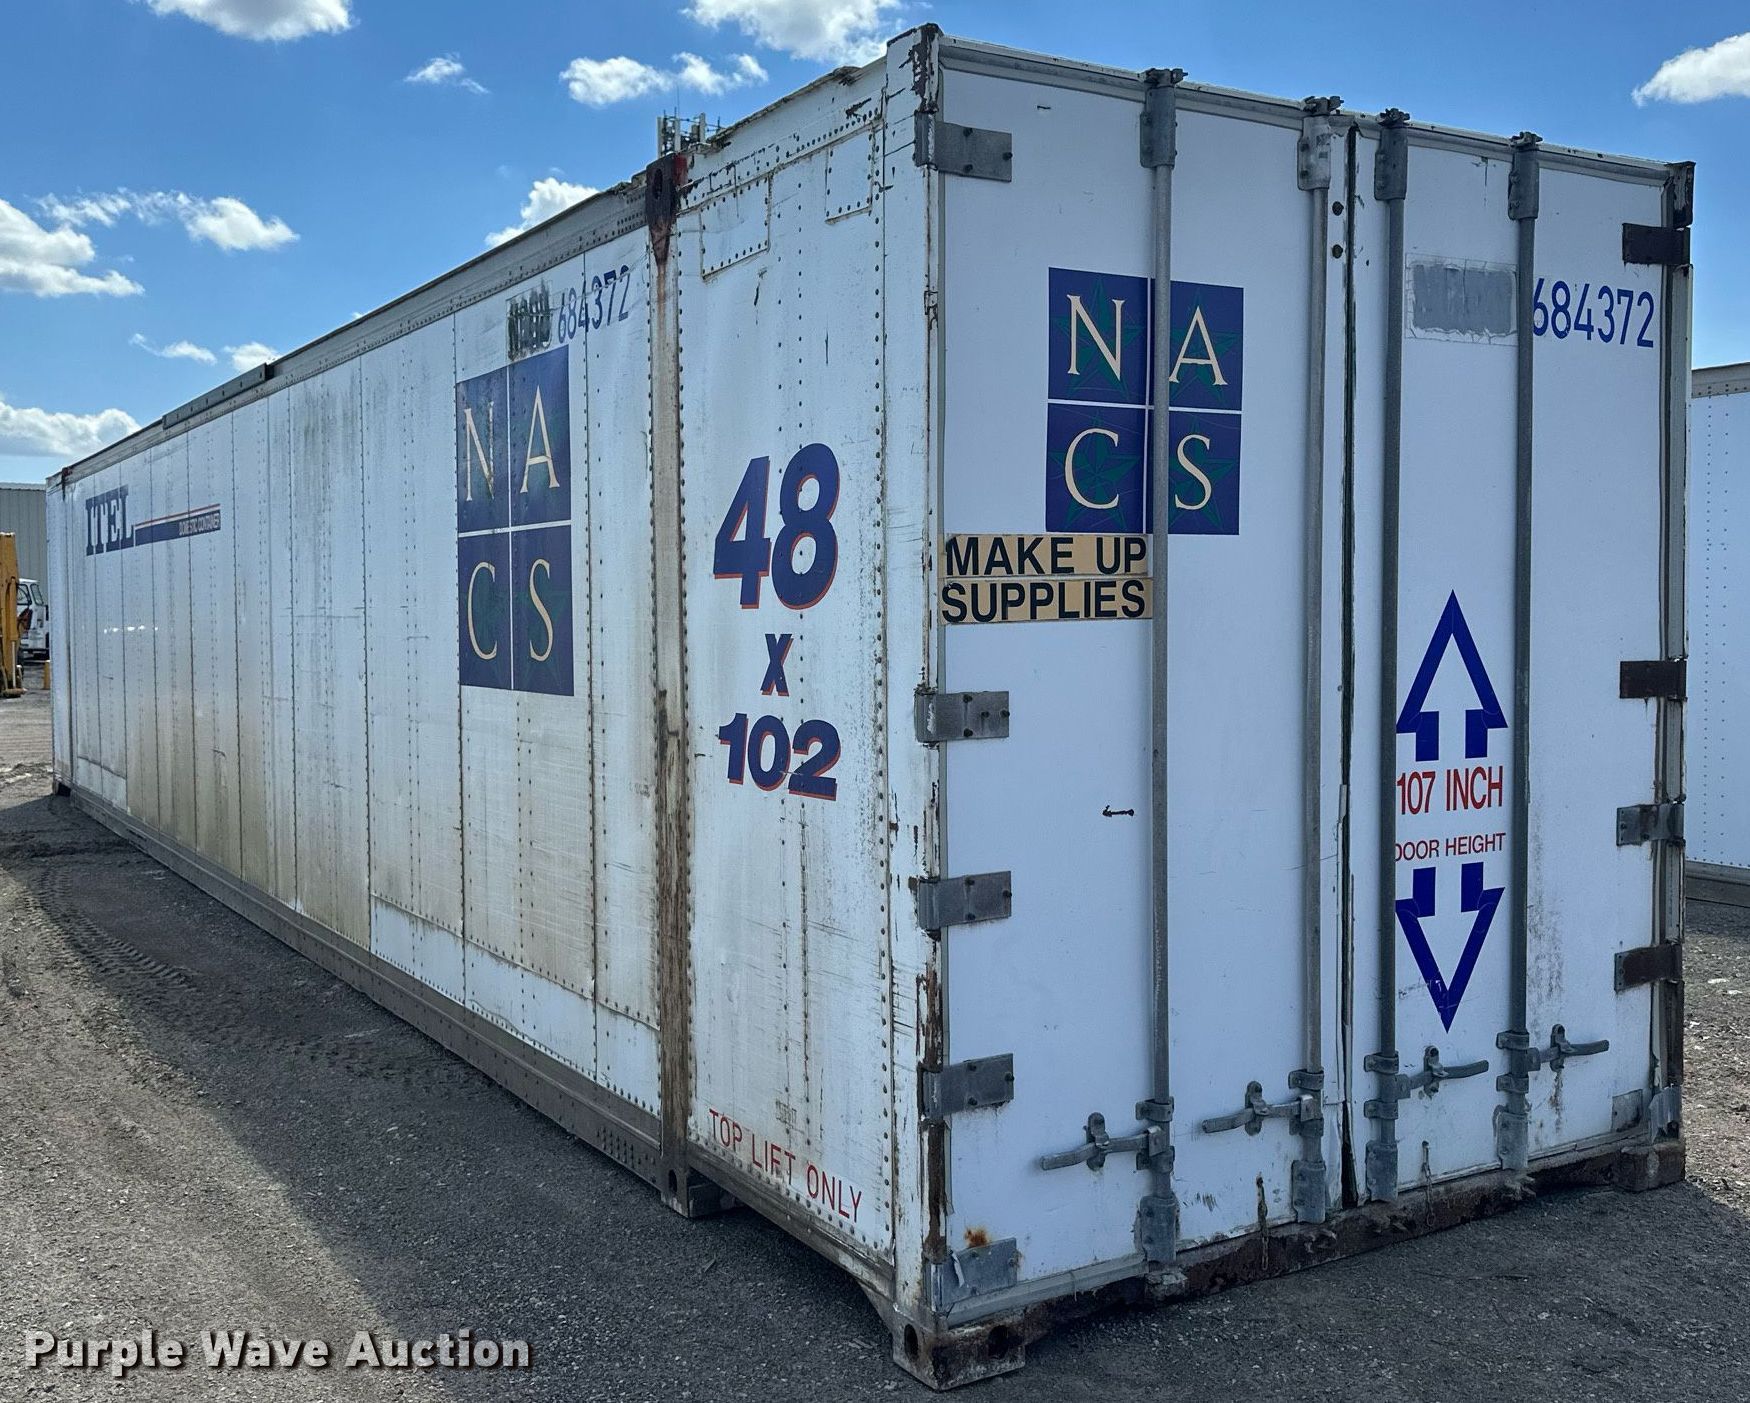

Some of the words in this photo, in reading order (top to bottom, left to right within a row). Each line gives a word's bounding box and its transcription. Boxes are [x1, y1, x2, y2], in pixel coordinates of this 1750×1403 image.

[558, 265, 631, 343] 684372
[1533, 277, 1655, 348] 684372
[85, 484, 134, 556] ITEL
[713, 443, 840, 610] 48
[946, 536, 1075, 576] MAKE
[1096, 536, 1147, 575] UP
[942, 579, 1146, 624] SUPPLIES
[718, 712, 841, 801] 102
[1396, 771, 1436, 815] 107
[1446, 765, 1504, 811] INCH
[1395, 839, 1440, 861] DOOR
[1445, 833, 1507, 857] HEIGHT
[709, 1108, 743, 1151] TOP
[752, 1133, 796, 1185] LIFT
[807, 1164, 862, 1223] ONLY
